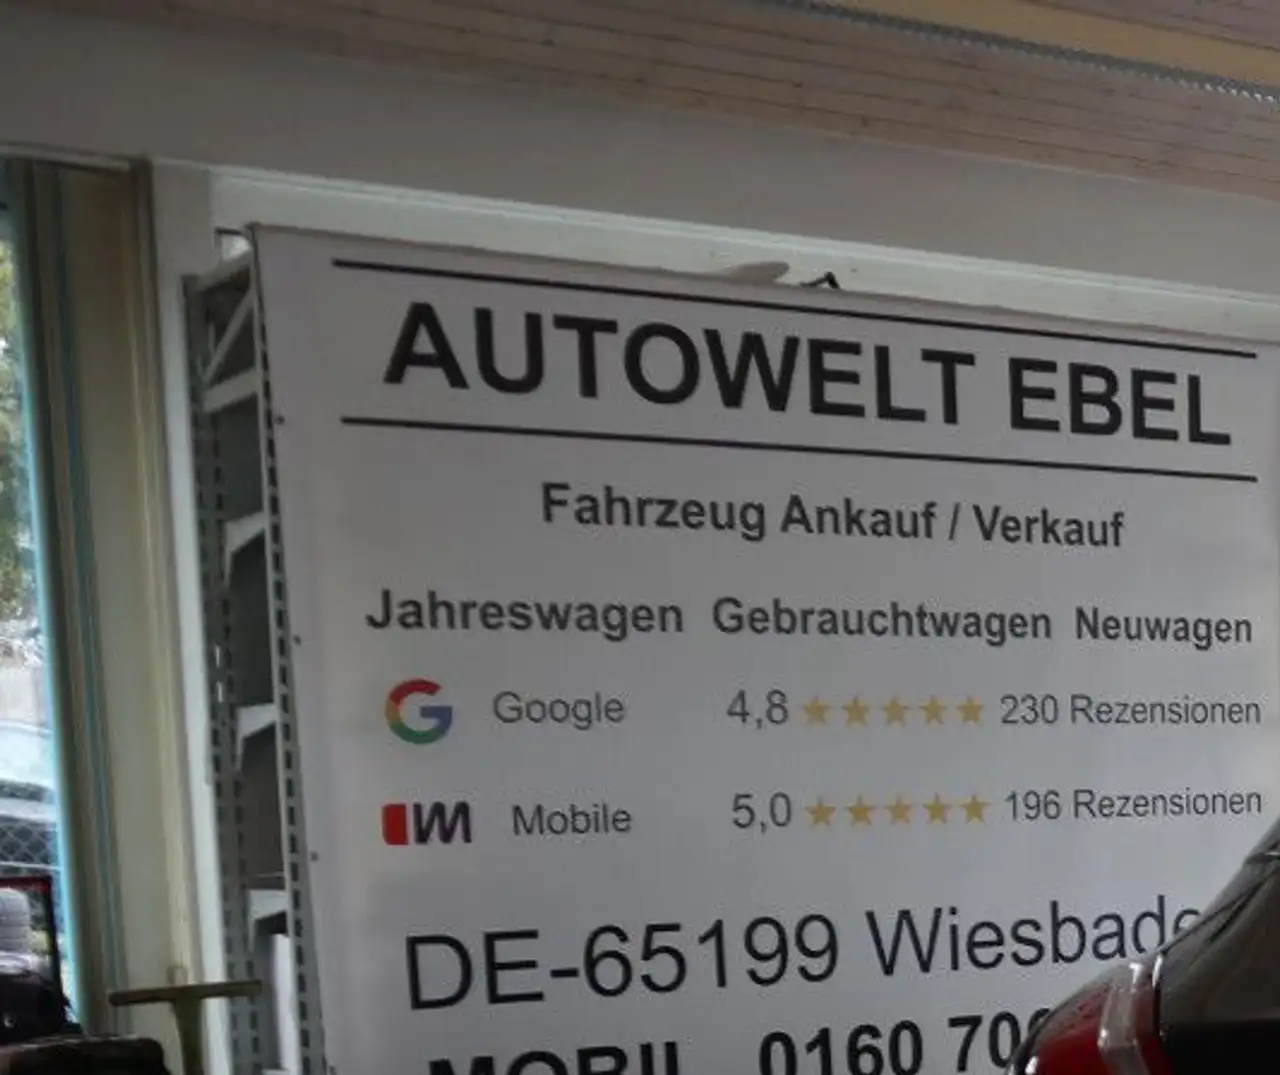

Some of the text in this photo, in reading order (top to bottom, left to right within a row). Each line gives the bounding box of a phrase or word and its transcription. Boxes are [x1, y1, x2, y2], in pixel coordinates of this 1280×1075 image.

[383, 301, 1231, 446] AUTOWELT EBEL
[541, 481, 1125, 548] Fahrzeug Ankauf / Verkauf
[364, 587, 1252, 652] Jahreswagen Gebrauchtwagen Neuwagen
[492, 688, 1261, 731] Google 4,8 230 Rezensionen
[511, 786, 1262, 837] Mobile 5,0 196 Rezensionen
[404, 913, 839, 1012] DE-65199
